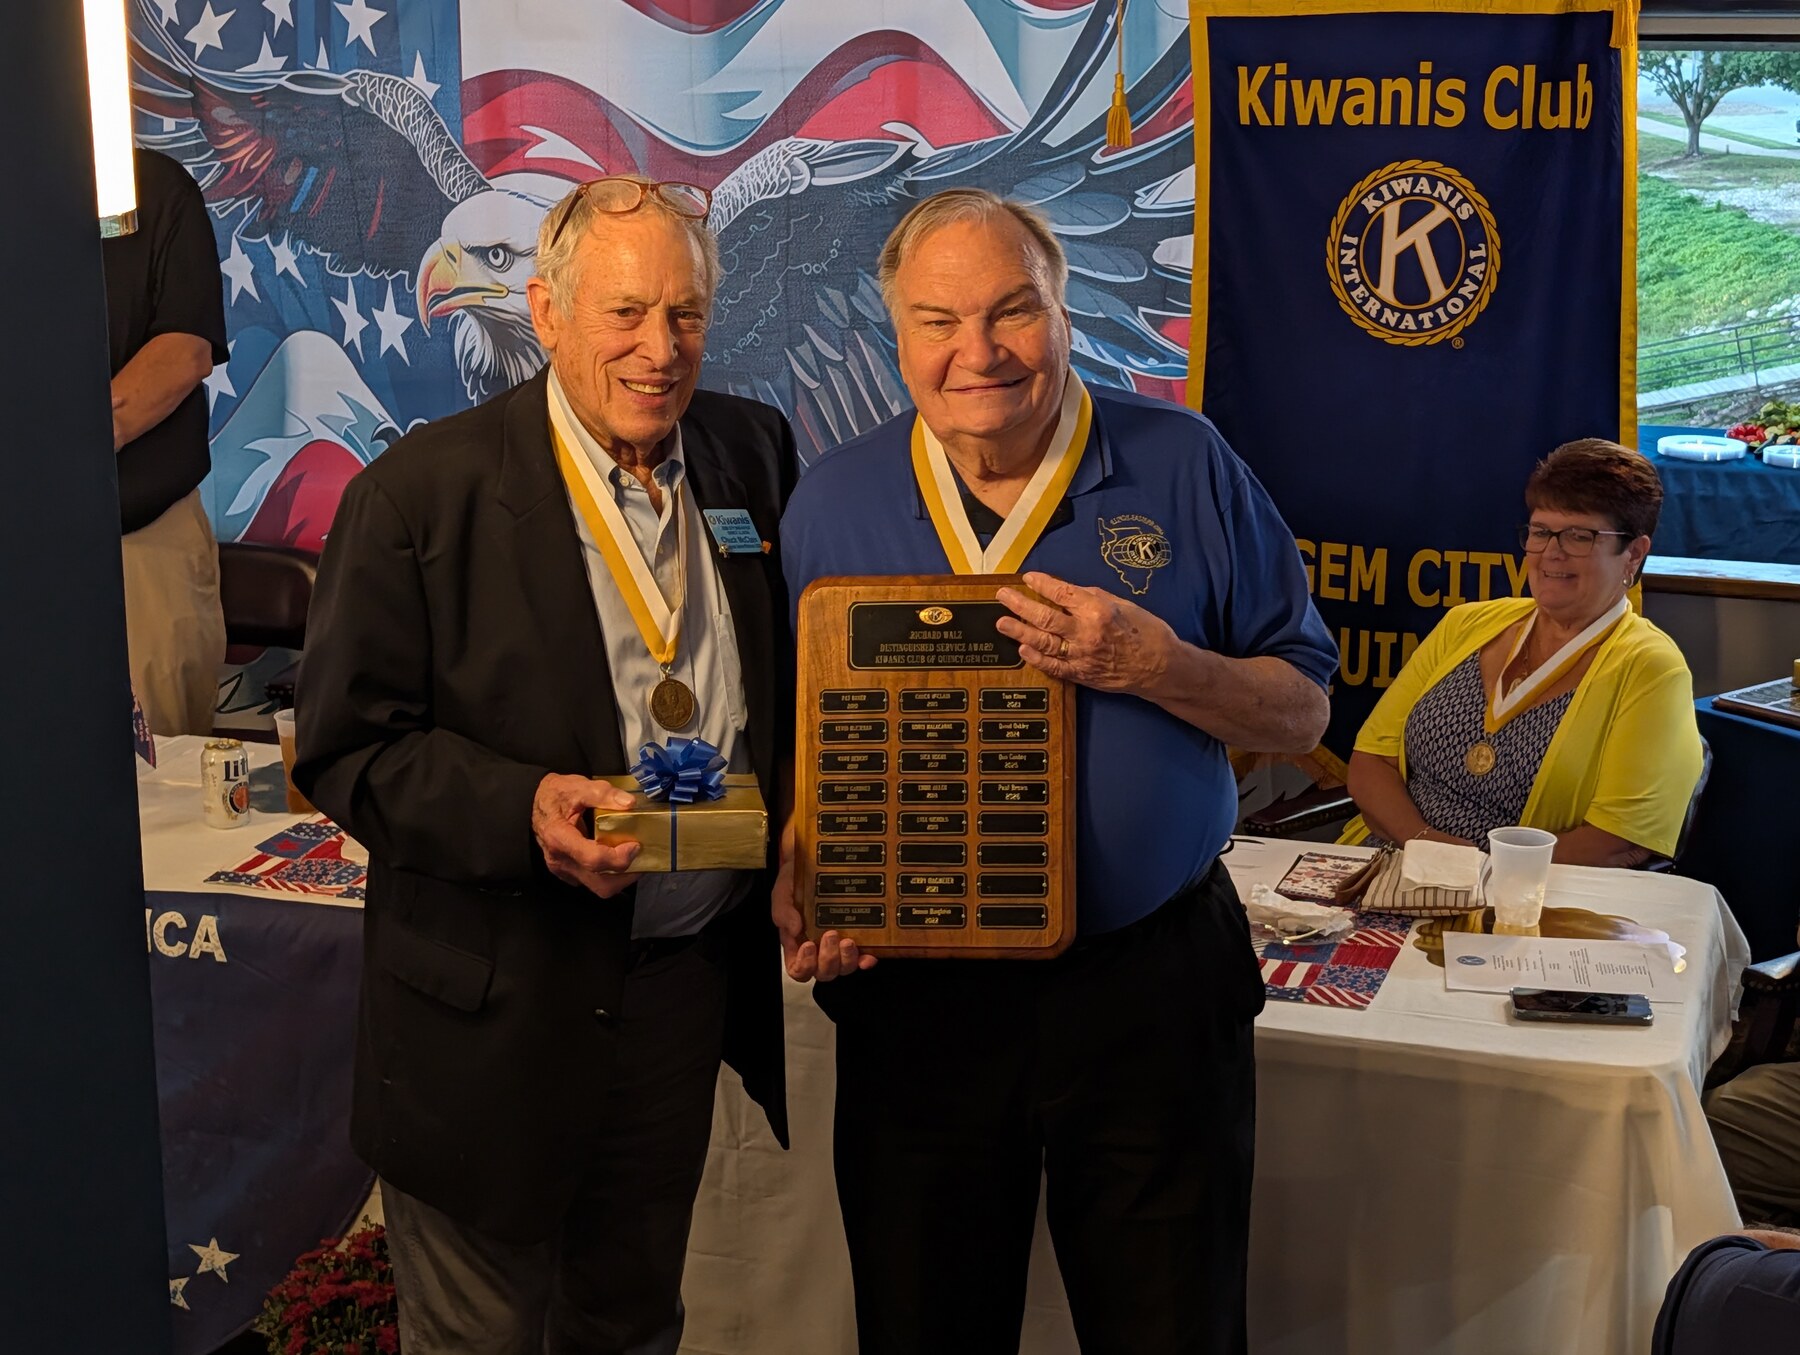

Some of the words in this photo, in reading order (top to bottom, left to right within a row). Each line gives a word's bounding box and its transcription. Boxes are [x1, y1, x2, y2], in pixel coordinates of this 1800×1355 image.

[1237, 61, 1466, 128] Kiwanis
[1483, 63, 1593, 130] Club
[1360, 176, 1475, 221] KIWANIS
[1378, 197, 1451, 304] K
[1340, 234, 1487, 331] INTERNATIONAL
[715, 514, 751, 525] Kiwanis
[1138, 541, 1155, 560] K
[1295, 538, 1388, 606] GEM
[1407, 548, 1529, 608] CITY
[879, 643, 935, 653] DISTINGUISHED
[936, 643, 966, 652] SERVICE
[968, 642, 994, 652] AWARD
[909, 630, 941, 640] RICHARD
[943, 630, 963, 640] WALZ
[875, 655, 906, 664] KIWANIS
[907, 655, 925, 664] CLUB
[926, 655, 936, 664] OF
[982, 654, 999, 664] CITY
